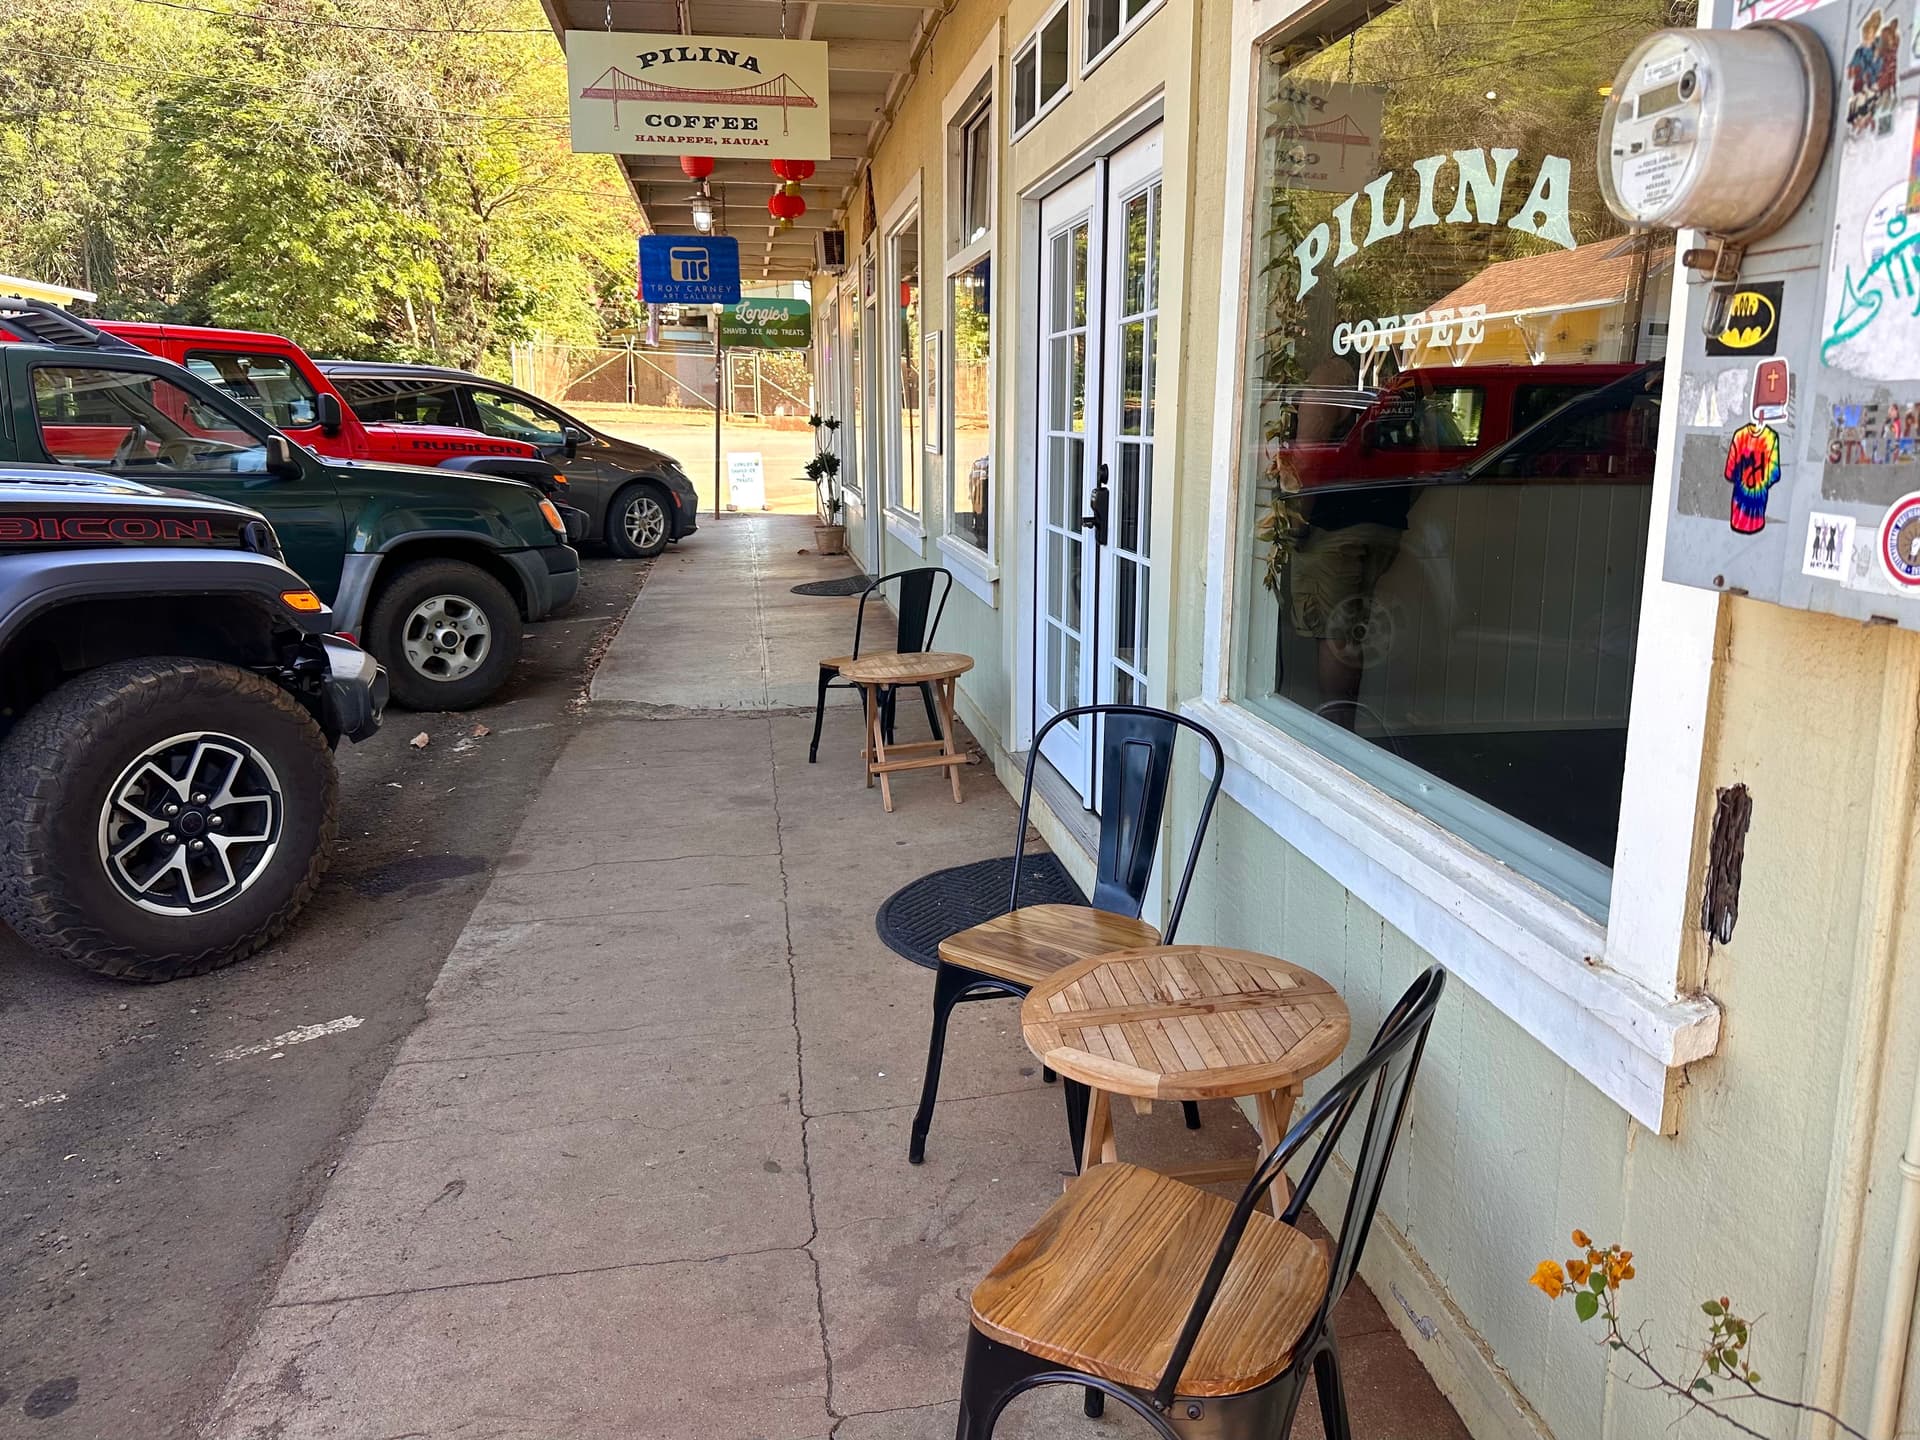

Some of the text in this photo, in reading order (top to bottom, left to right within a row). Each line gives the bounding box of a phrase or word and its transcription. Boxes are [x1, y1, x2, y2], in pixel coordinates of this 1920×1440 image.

[636, 46, 762, 75] PILINA
[644, 114, 758, 130] COFFEE
[635, 134, 718, 146] HANAPEPE,
[1293, 147, 1577, 302] PILINA
[650, 284, 732, 293] TROY CARNEY
[735, 301, 789, 327] Longies
[722, 327, 748, 335] SHAVED
[765, 328, 779, 336] AND
[782, 328, 805, 336] TREATS
[1332, 303, 1487, 356] COFFEE
[412, 440, 523, 454] RUBICON
